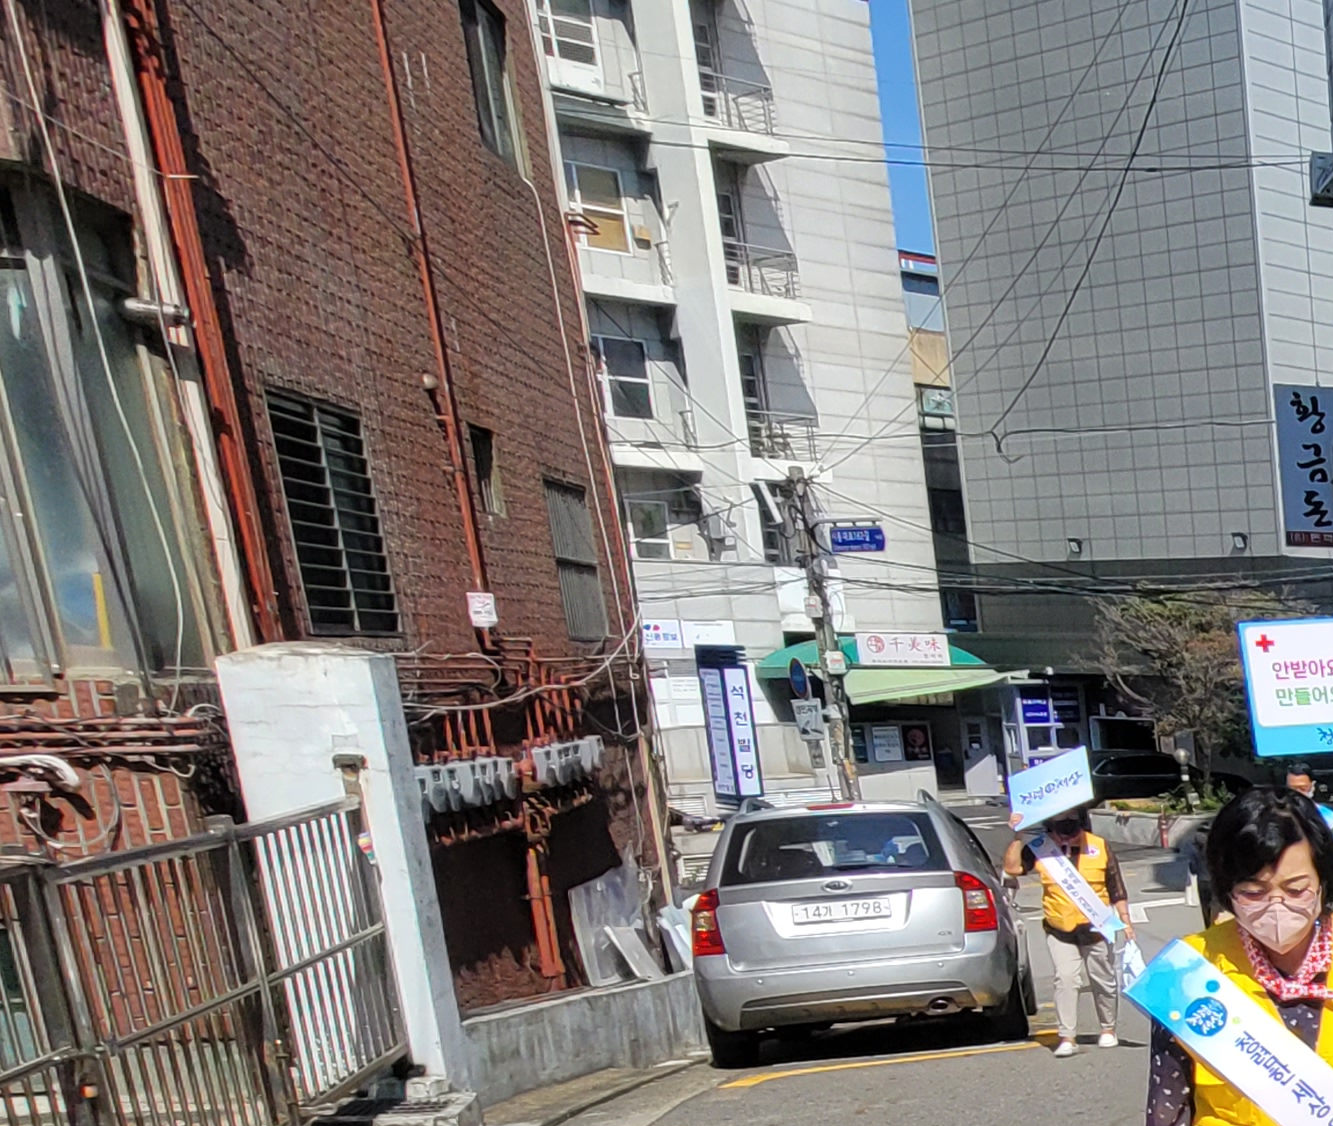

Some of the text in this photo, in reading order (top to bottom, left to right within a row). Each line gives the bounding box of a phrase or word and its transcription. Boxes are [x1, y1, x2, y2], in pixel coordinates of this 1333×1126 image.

[841, 901, 882, 917] 1798
[1233, 1030, 1297, 1087] 청렴한
[1291, 1079, 1332, 1120] 세상
